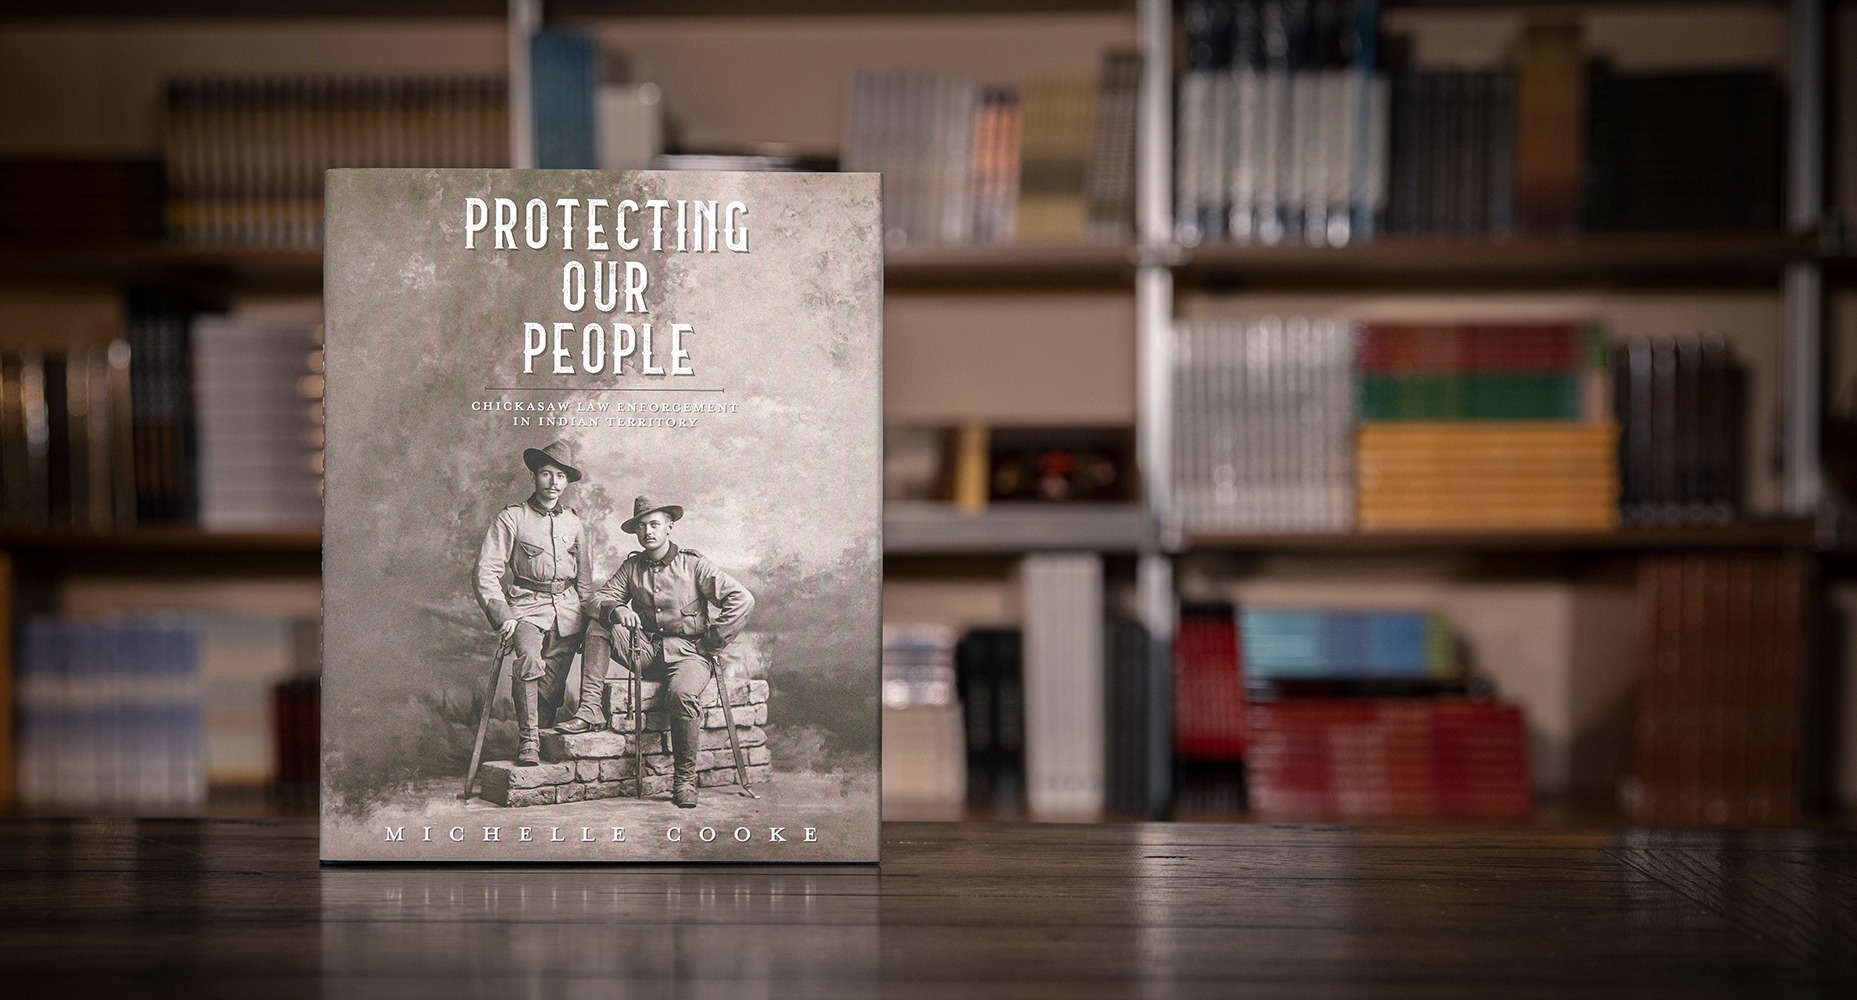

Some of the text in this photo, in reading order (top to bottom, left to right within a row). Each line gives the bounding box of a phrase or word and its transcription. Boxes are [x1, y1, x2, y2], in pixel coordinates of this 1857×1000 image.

[464, 197, 750, 253] PROTECTING
[562, 260, 650, 313] OUR
[522, 322, 695, 376] PEOPLE
[471, 401, 740, 414] CHICKASAW LAW ENFORCEMENT
[513, 416, 699, 428] IN INDIAN TERRITORY
[384, 826, 820, 844] MICHELLE COOKE
